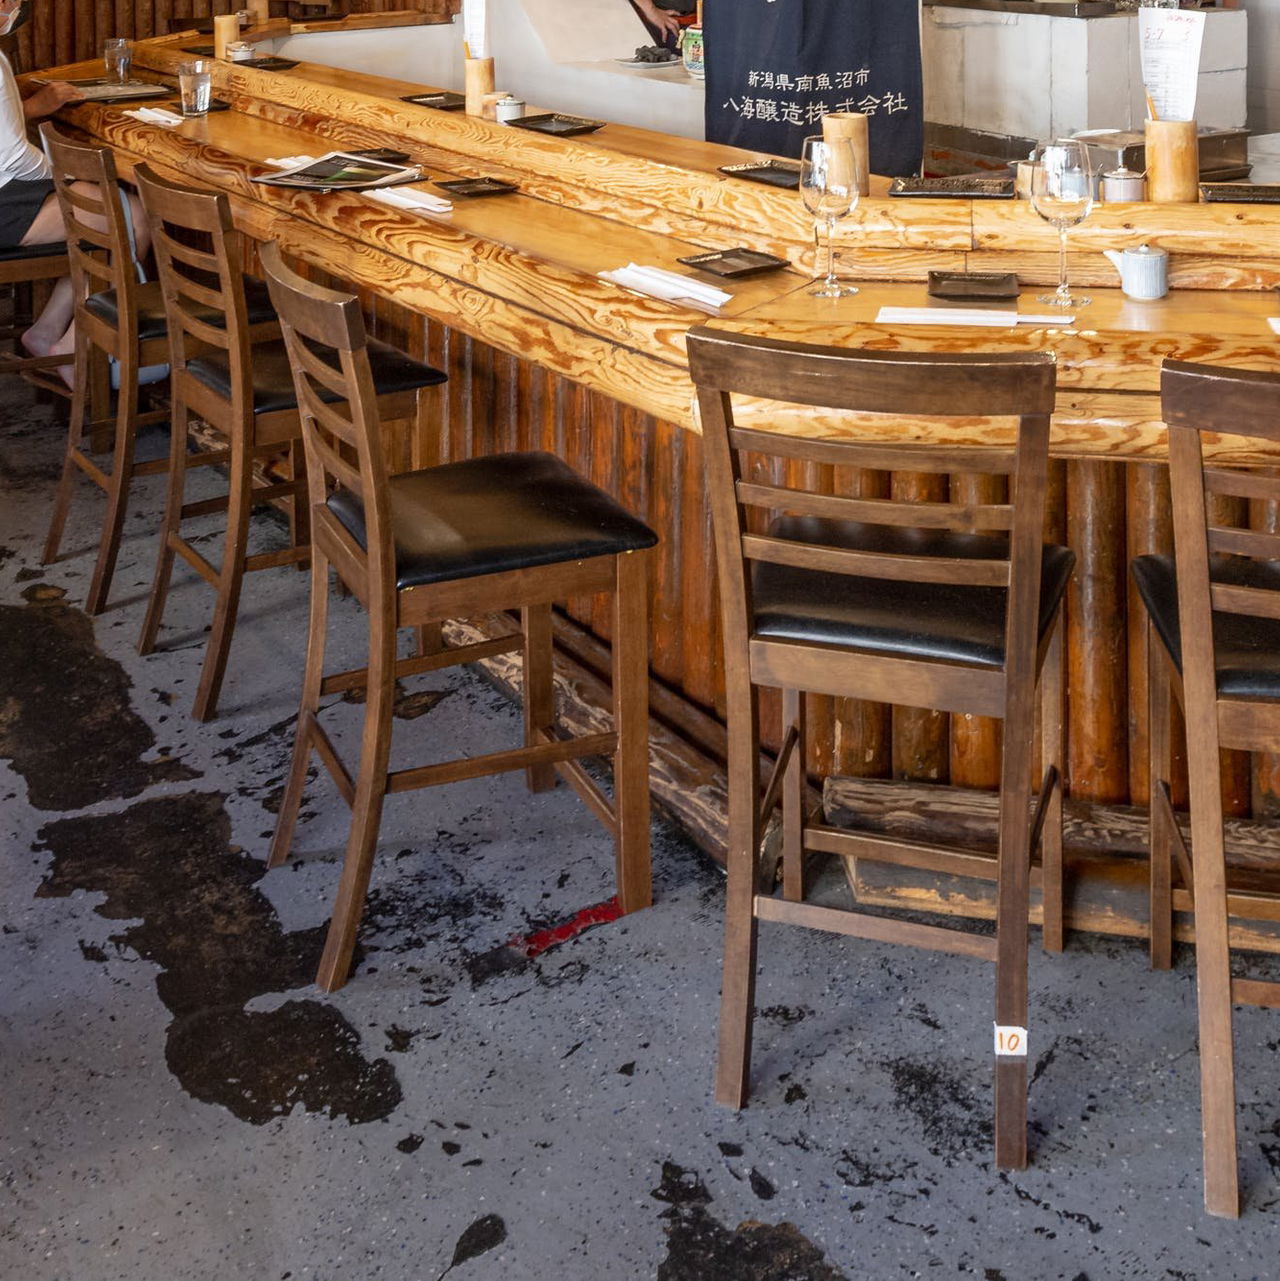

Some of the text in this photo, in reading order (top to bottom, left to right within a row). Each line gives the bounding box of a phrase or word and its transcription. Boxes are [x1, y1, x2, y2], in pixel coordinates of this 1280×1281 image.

[747, 68, 871, 93] 新潟県南魚沼市
[997, 1032, 1021, 1052] 10
